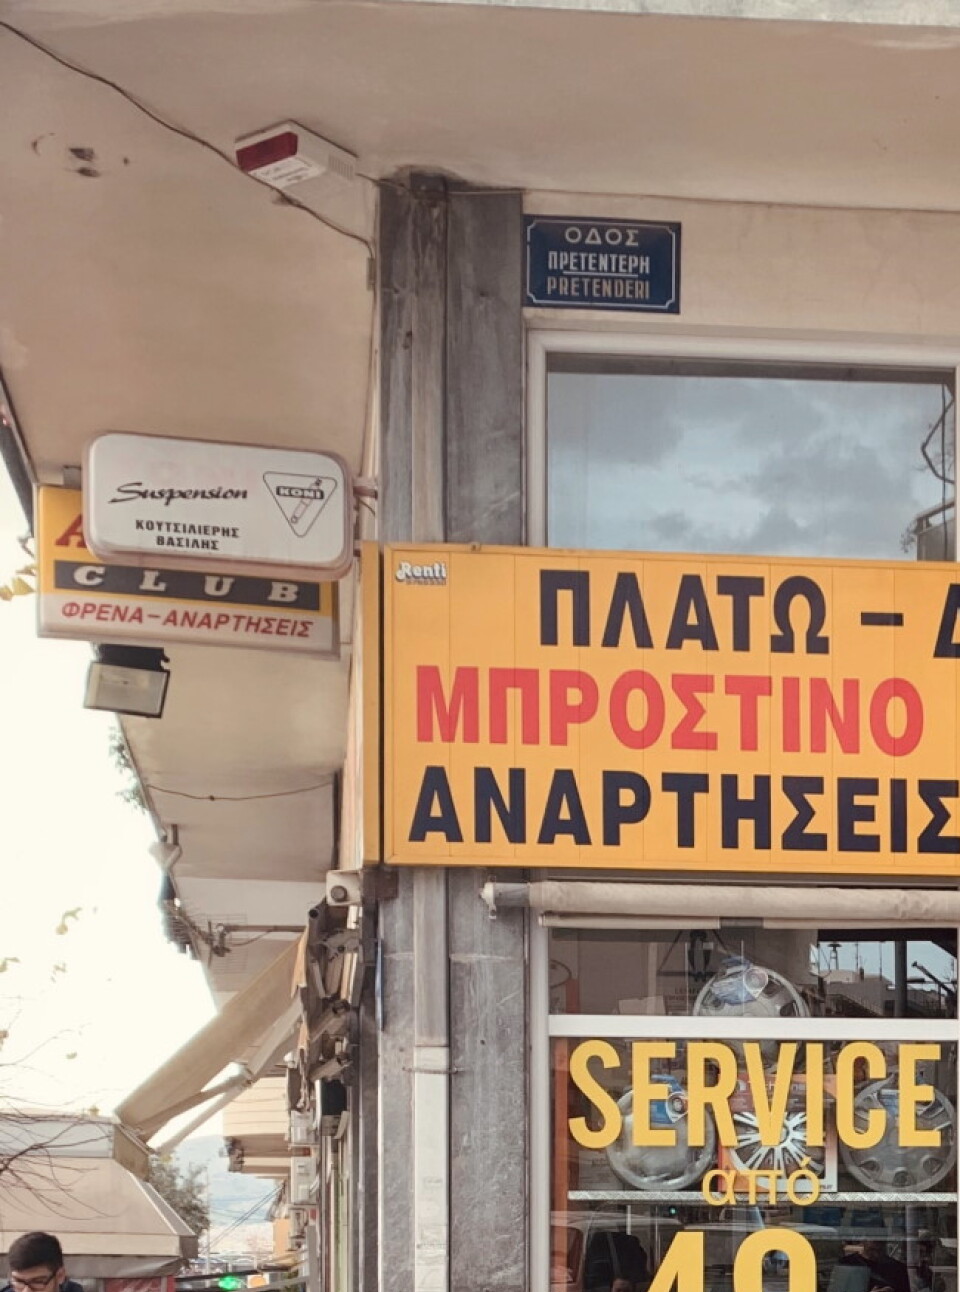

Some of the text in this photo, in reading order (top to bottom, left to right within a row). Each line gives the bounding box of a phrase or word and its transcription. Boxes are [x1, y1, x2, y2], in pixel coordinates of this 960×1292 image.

[565, 226, 639, 246] ΟΔΟΣ
[548, 250, 650, 274] ΠΡΕΤΕΝΤΕΡΗ
[547, 276, 649, 299] PRETENDERI
[108, 482, 248, 506] Suspension
[277, 487, 322, 500] KONI
[135, 519, 240, 538] ΚΟΥΤΣΙΛΙΕΡΗΣ
[156, 535, 219, 550] ΒΑΣΙΛΗΣ
[539, 569, 830, 655] ΠΛΑΤΩ
[416, 665, 925, 757] ΜΠΡΟΣΤΙΝΟ
[568, 1039, 942, 1149] SERVICE
[702, 1156, 821, 1206] από
